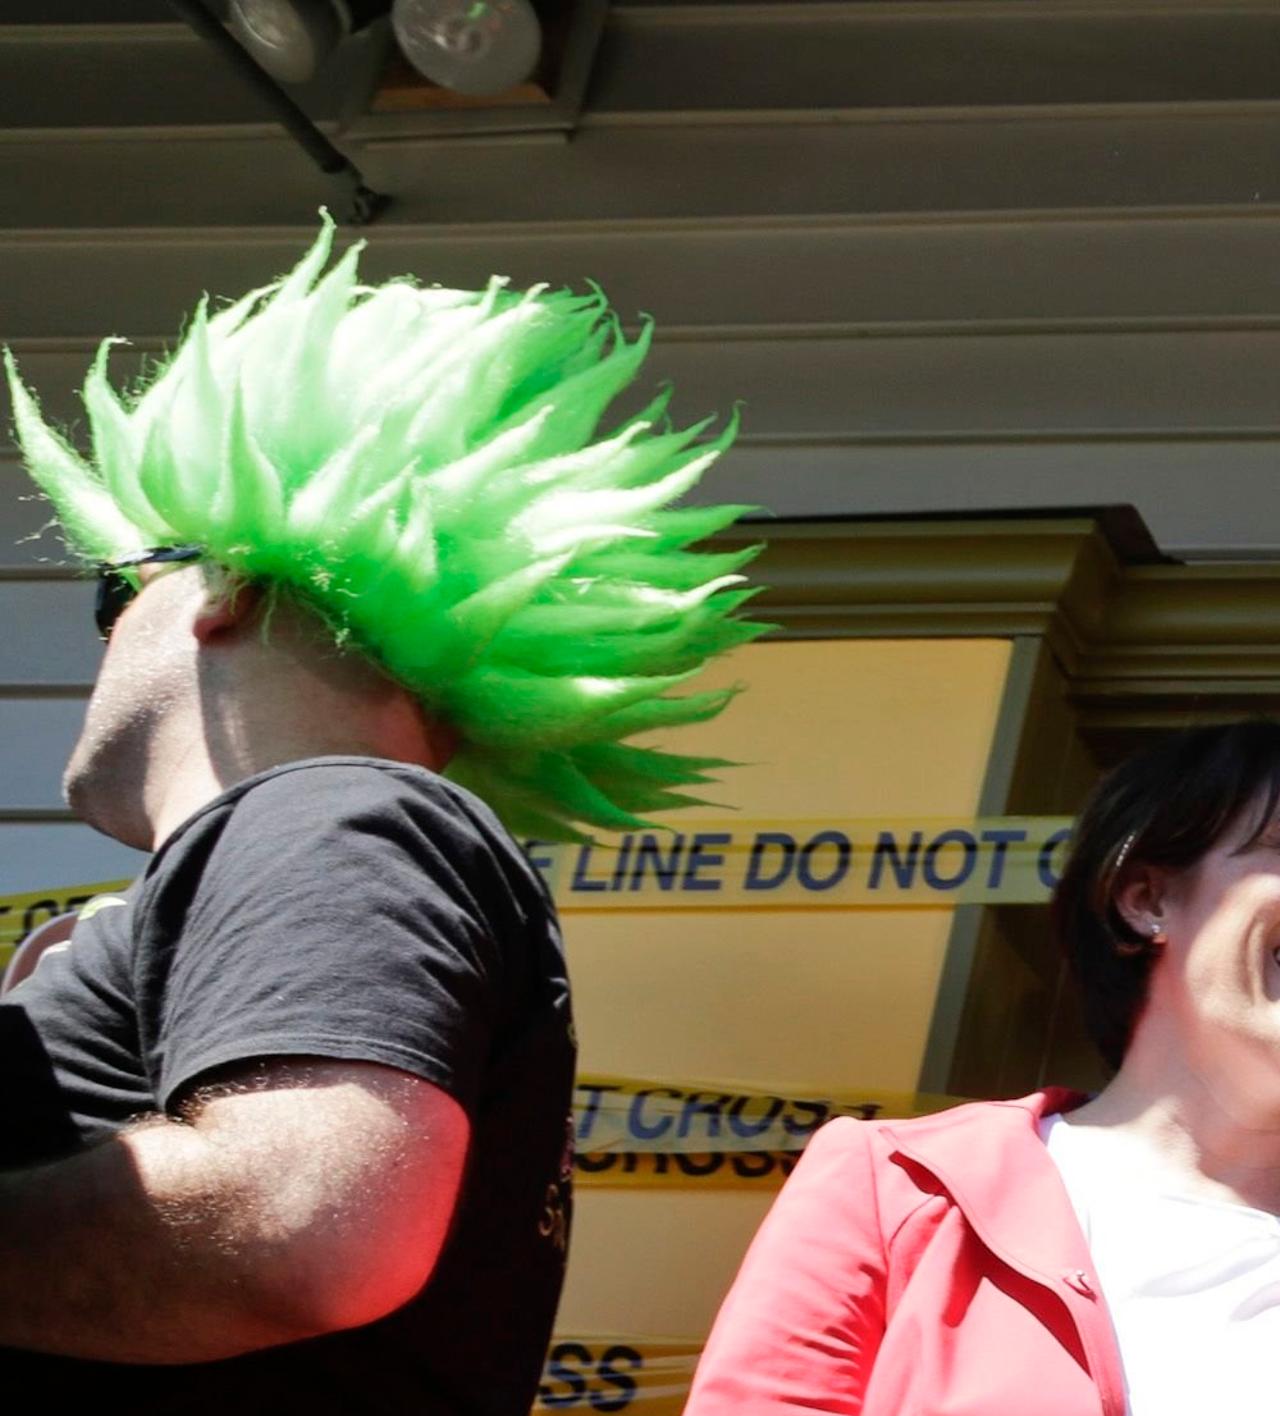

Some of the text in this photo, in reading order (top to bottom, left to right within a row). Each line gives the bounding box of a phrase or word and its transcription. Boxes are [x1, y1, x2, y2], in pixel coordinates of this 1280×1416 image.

[570, 832, 731, 892] LINE
[743, 830, 851, 892] DO
[867, 829, 1028, 890] NOT
